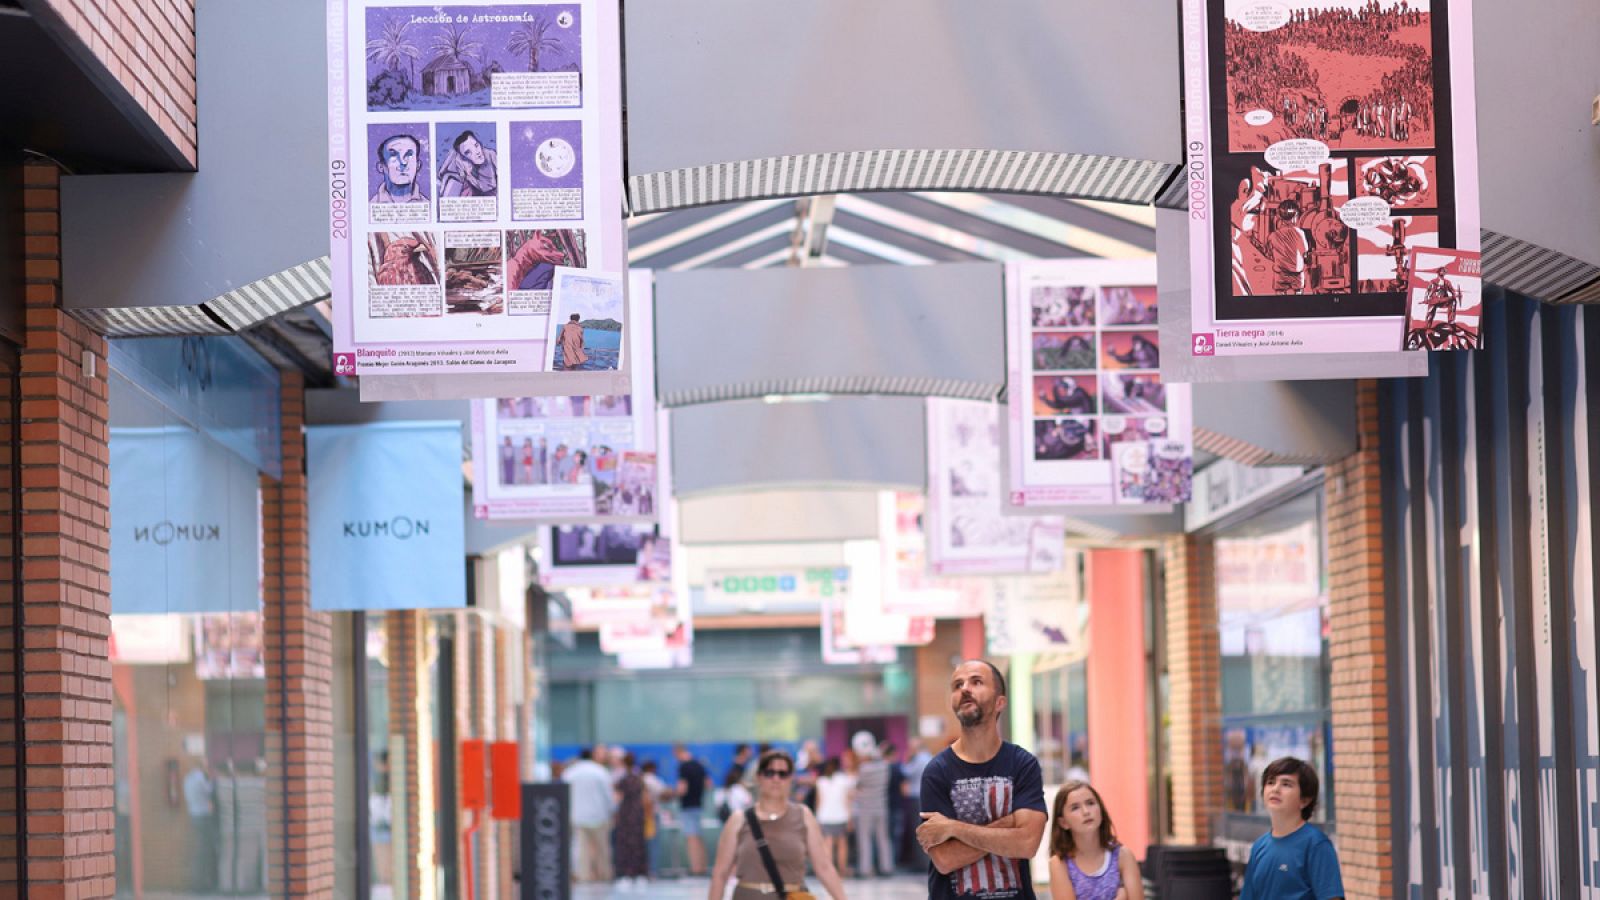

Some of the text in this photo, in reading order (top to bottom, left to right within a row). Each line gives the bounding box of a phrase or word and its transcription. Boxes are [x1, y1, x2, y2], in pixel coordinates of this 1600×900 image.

[410, 12, 534, 24] Lección de Astronomía
[1187, 41, 1200, 62] de
[330, 60, 344, 80] de
[1187, 68, 1202, 109] años
[332, 86, 344, 128] años
[1216, 329, 1240, 337] Tierra
[1241, 330, 1265, 338] negra
[357, 348, 397, 359] Blanquito
[343, 516, 430, 540] KUMON
